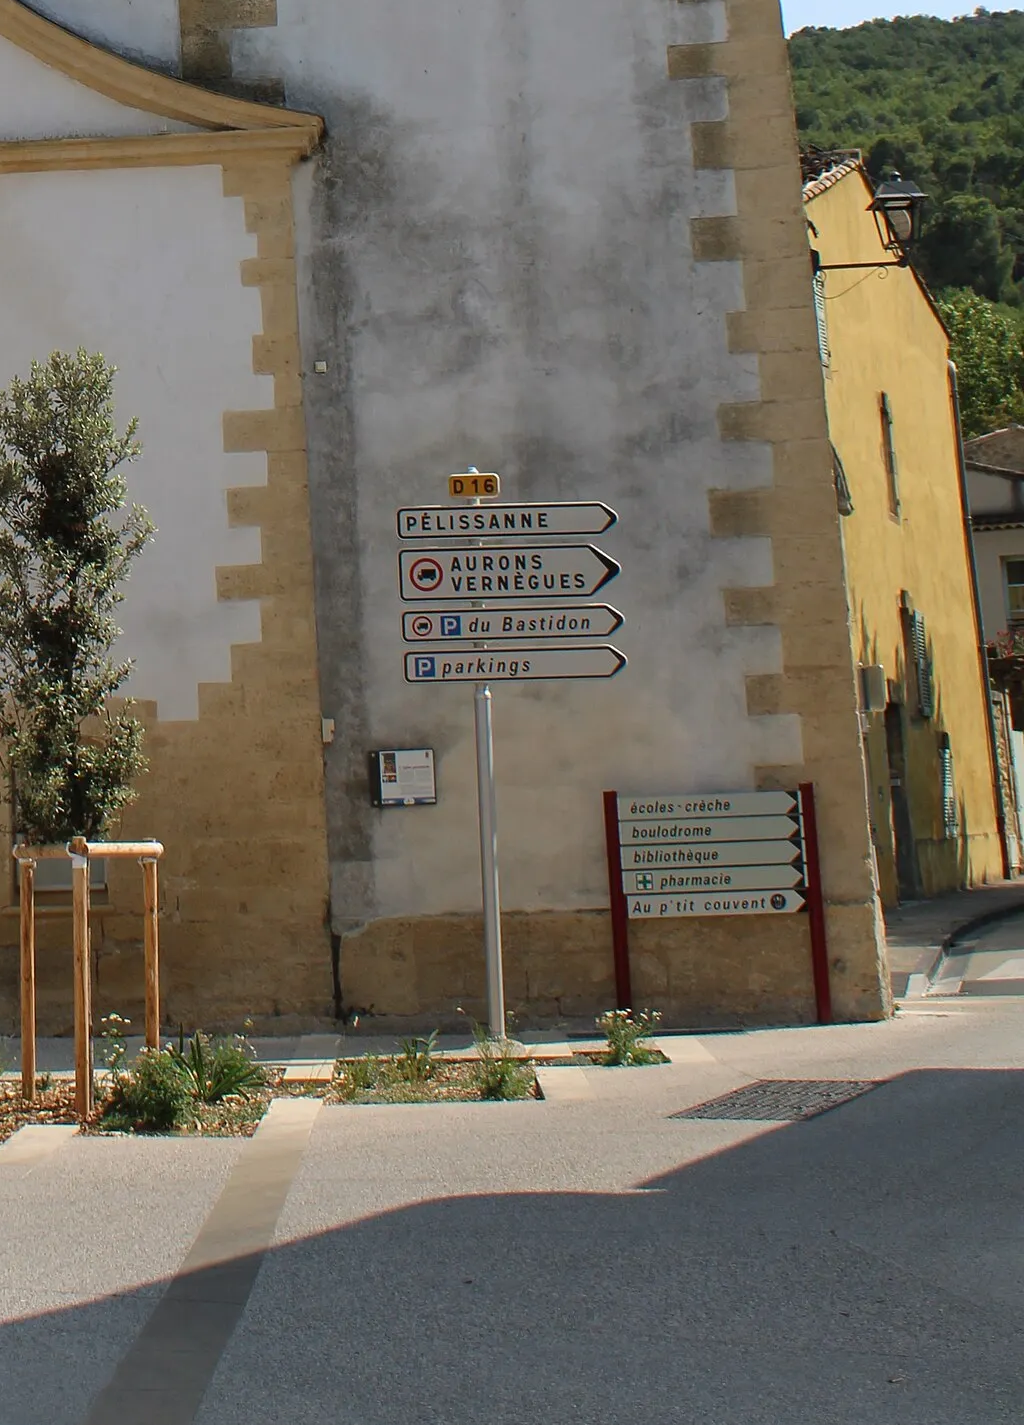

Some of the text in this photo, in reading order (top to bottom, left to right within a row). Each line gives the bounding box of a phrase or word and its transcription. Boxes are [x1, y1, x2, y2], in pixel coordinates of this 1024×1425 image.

[452, 478, 494, 494] D 16
[406, 512, 549, 531] PÉLISSANNE
[450, 554, 543, 572] AURONS
[450, 572, 586, 592] VERNÈGUES
[468, 617, 491, 633] du
[502, 615, 590, 632] Bastidon
[442, 657, 531, 678] parkings
[630, 801, 675, 815] écoles
[684, 799, 731, 812] crèche
[631, 825, 712, 839] boulodrome
[633, 848, 719, 863] bibliothèque
[660, 873, 732, 890] pharmacie
[632, 901, 651, 914] Au
[704, 897, 766, 911] couvent
